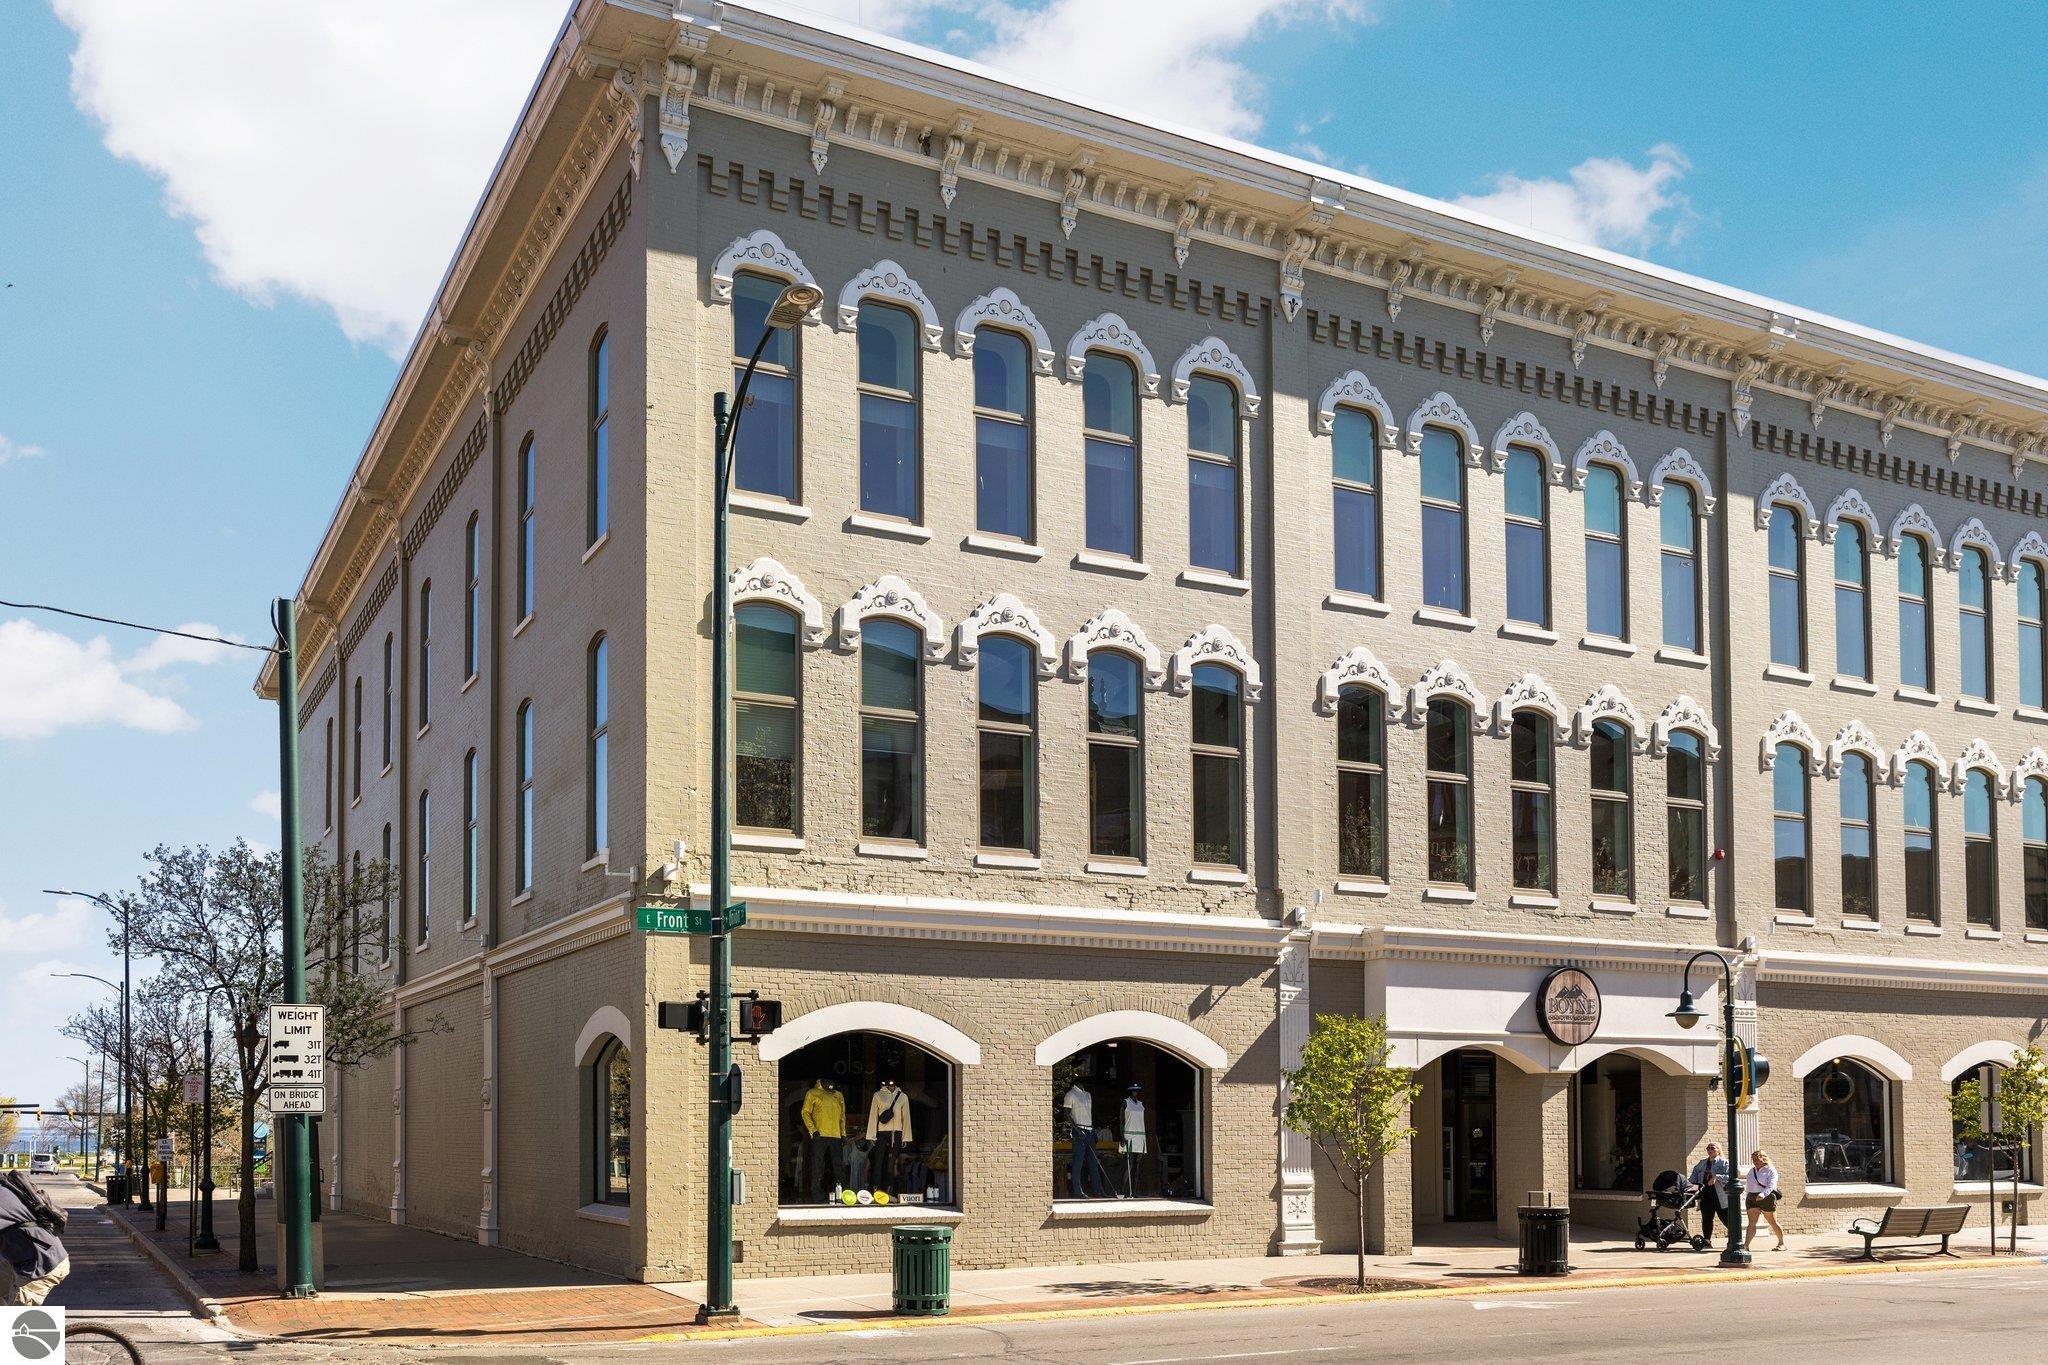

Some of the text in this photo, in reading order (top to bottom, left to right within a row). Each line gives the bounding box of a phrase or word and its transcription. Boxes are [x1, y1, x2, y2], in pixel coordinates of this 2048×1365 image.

[646, 911, 703, 928] E Front St
[1548, 998, 1597, 1014] BOYNE
[278, 1011, 319, 1020] WEIGHT
[284, 1026, 312, 1035] LIMIT
[307, 1040, 322, 1049] 31T
[304, 1055, 322, 1064] 32T
[307, 1069, 322, 1078] 41T
[274, 1091, 319, 1099] ON BRIDGE
[283, 1101, 311, 1109] AHEAD
